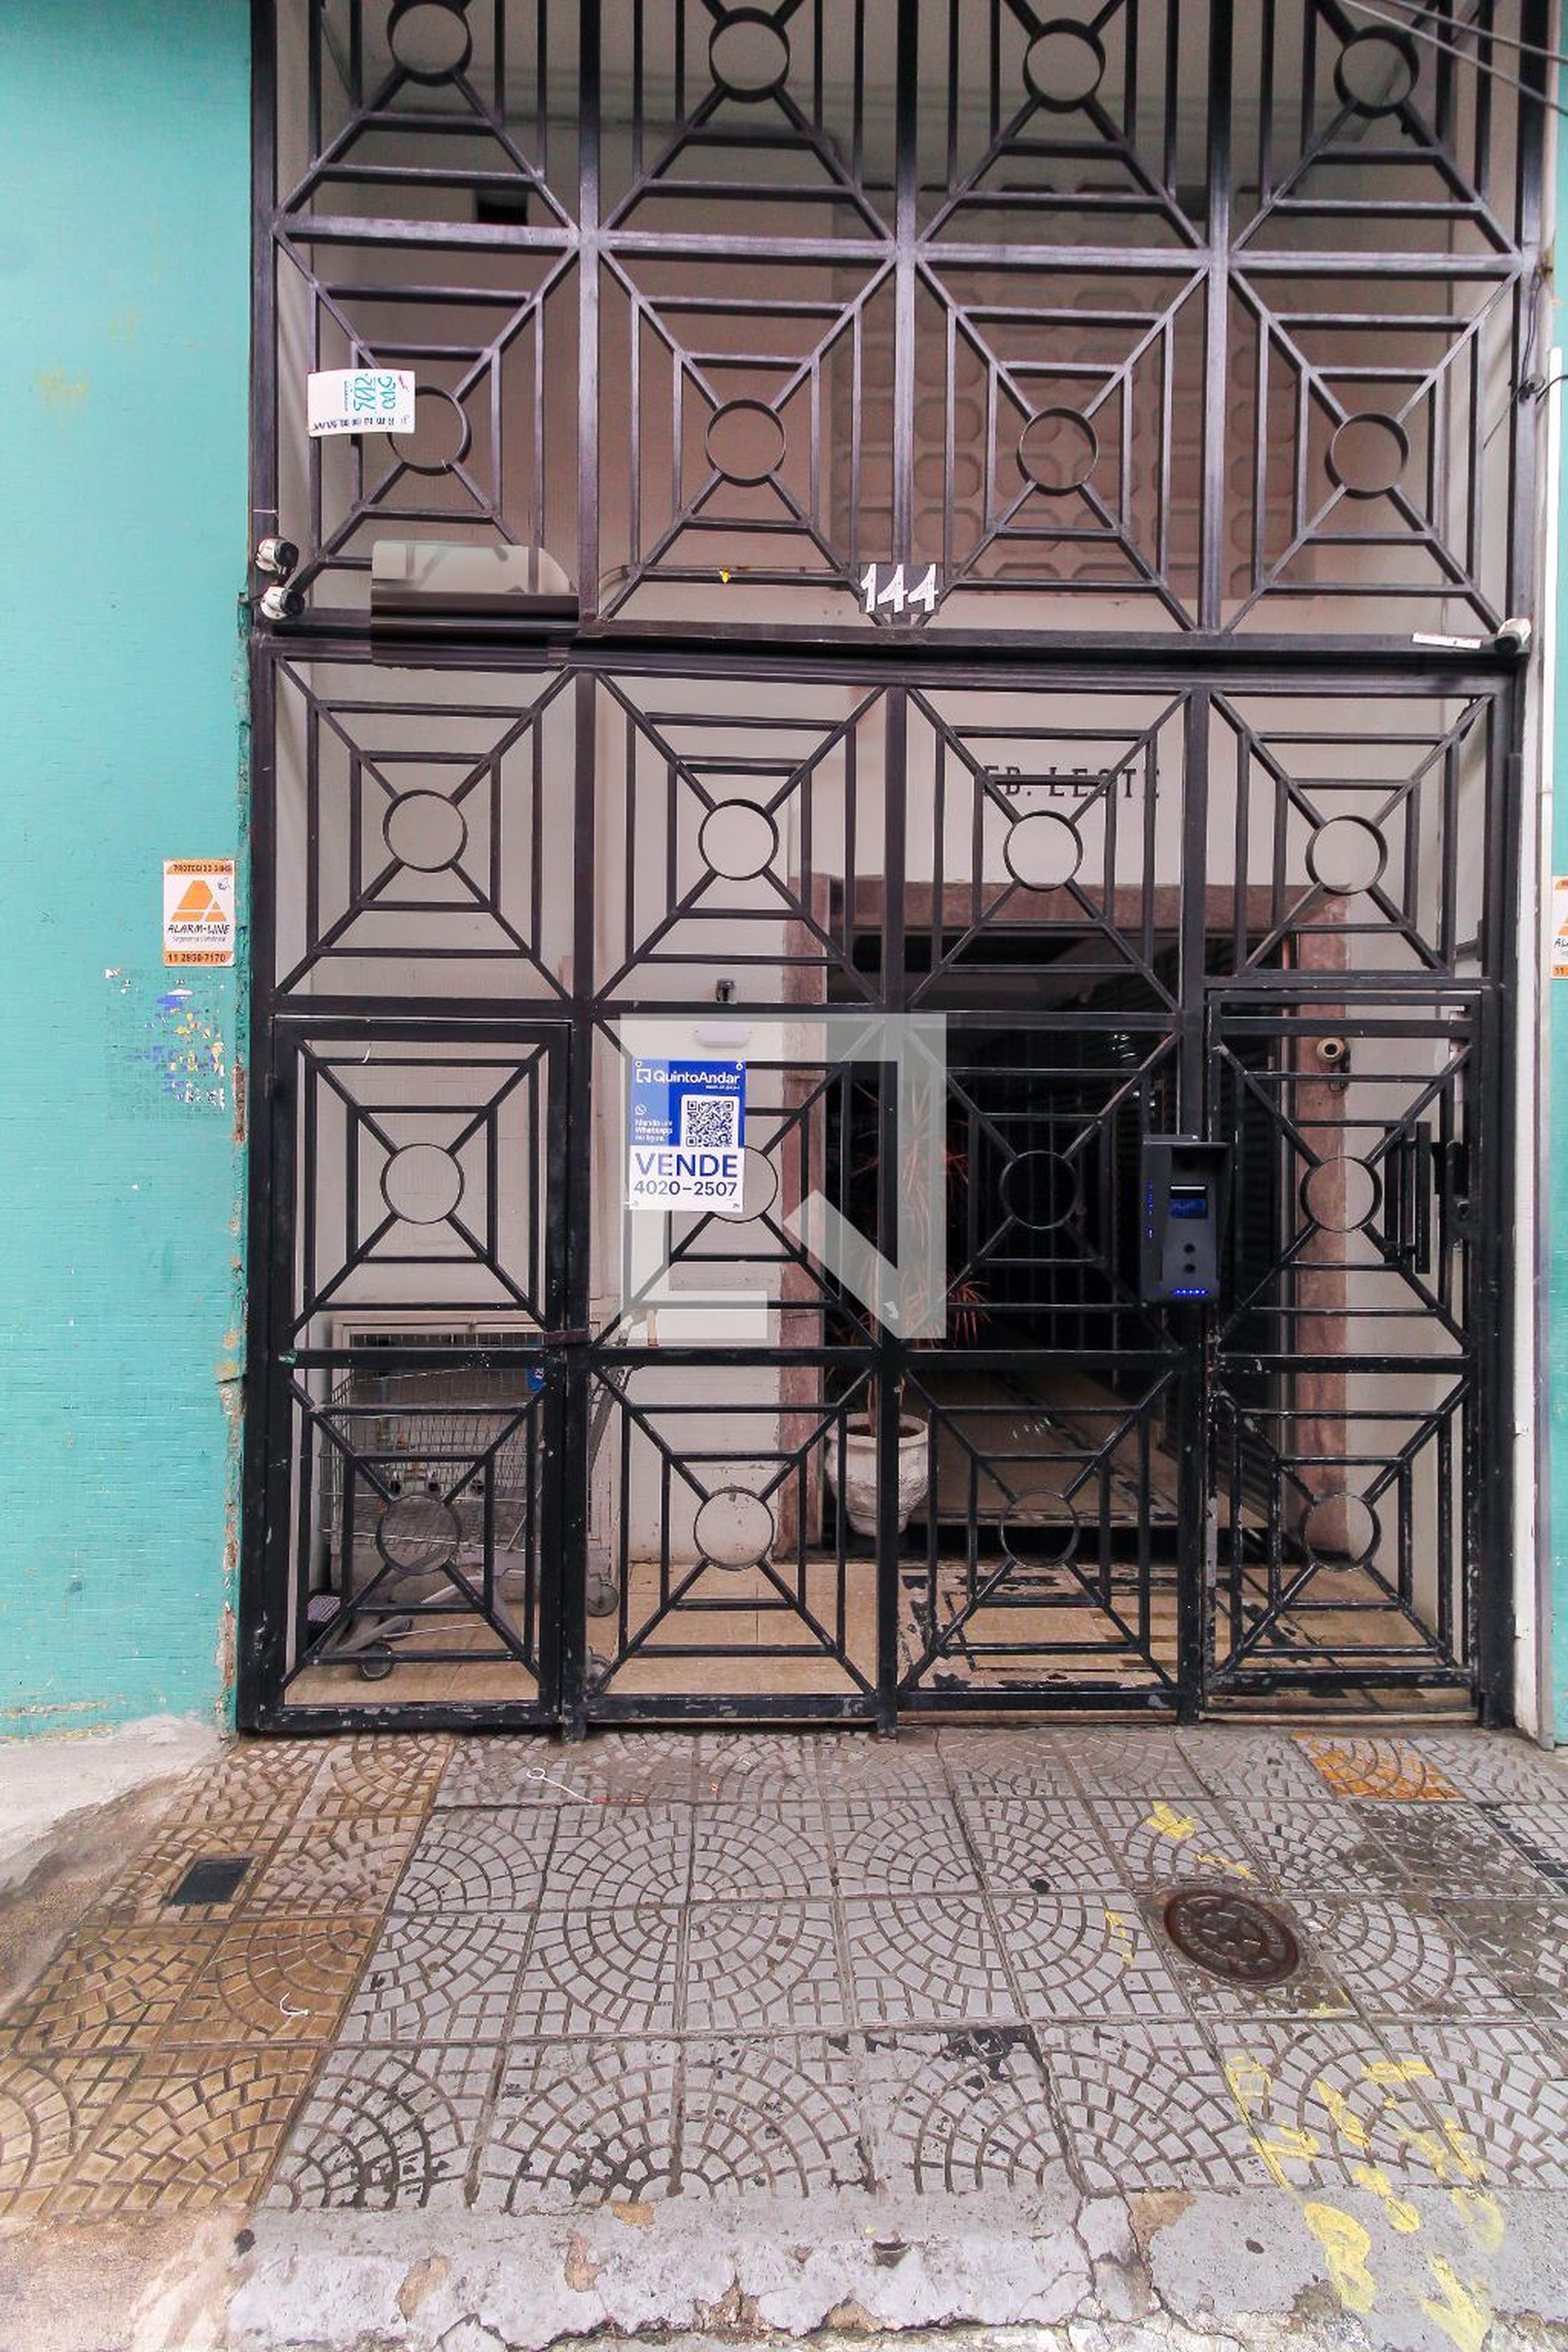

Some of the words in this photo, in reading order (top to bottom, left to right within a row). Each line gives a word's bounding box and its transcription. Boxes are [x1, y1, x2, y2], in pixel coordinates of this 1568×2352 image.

[860, 563, 939, 613] 144
[168, 924, 230, 935] ALARM-LINE
[653, 1070, 740, 1084] QuintoAndar
[635, 1153, 737, 1178] VENDE
[633, 1180, 737, 1196] 4020-2507
